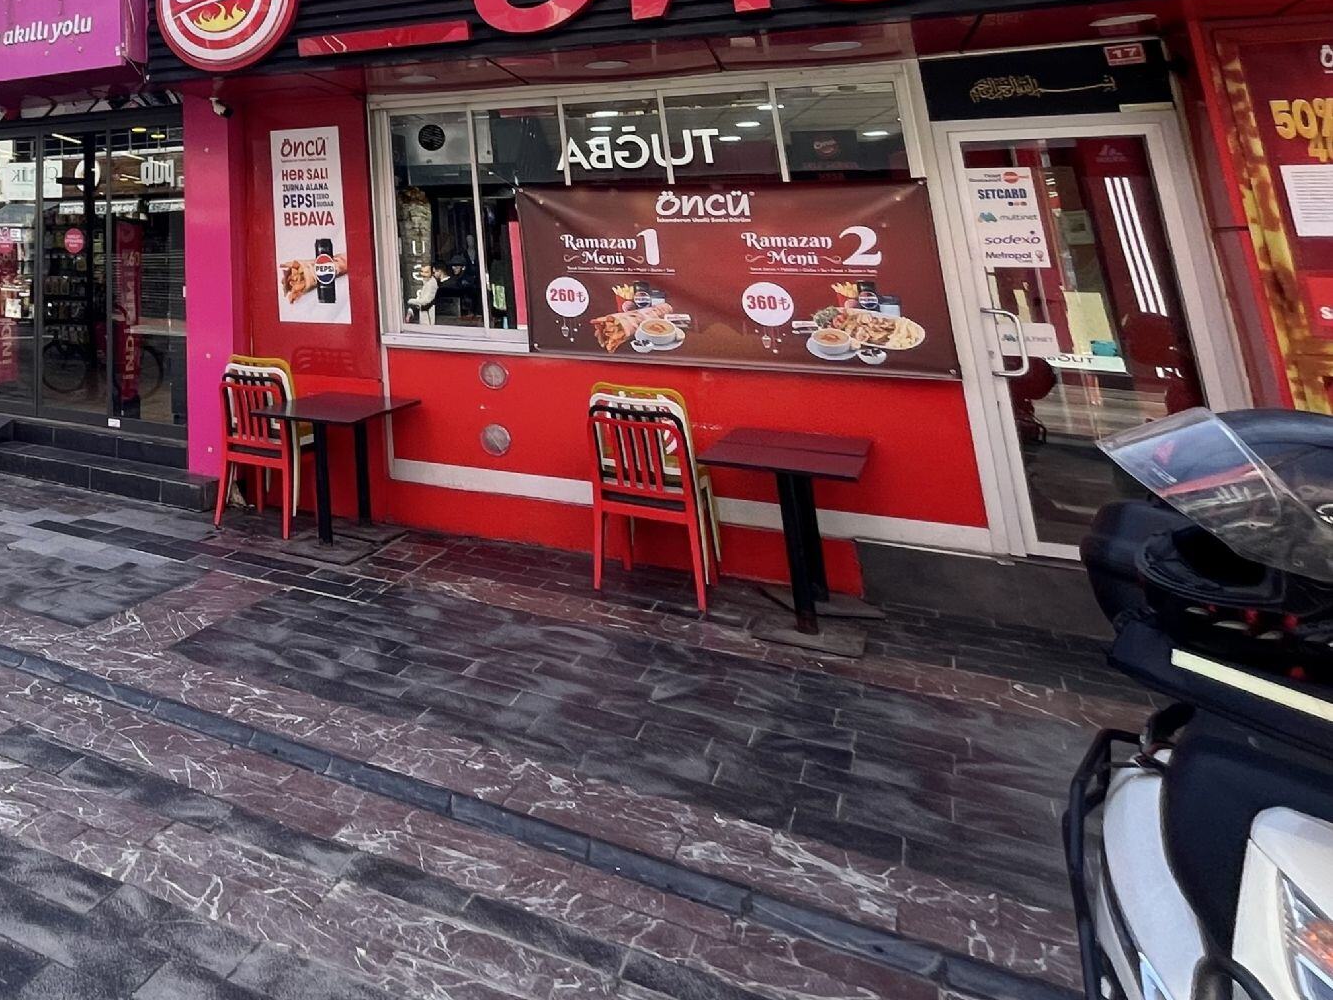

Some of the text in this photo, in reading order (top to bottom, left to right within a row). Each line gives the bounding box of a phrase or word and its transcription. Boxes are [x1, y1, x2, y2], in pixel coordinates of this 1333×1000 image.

[2, 23, 48, 45] akıllı
[49, 13, 93, 44] yolu
[306, 167, 329, 181] SALI
[305, 182, 329, 191] ALANA
[977, 187, 1028, 200] SETCARD
[282, 193, 316, 209] PEPSI
[283, 210, 335, 227] BEDAVA
[559, 228, 660, 266] Ramazan 1
[740, 225, 883, 267] Ramazan 2
[984, 234, 1041, 245] sodexo
[581, 249, 626, 266] Menü
[766, 248, 820, 267] Menü
[985, 251, 1032, 262] Metropol
